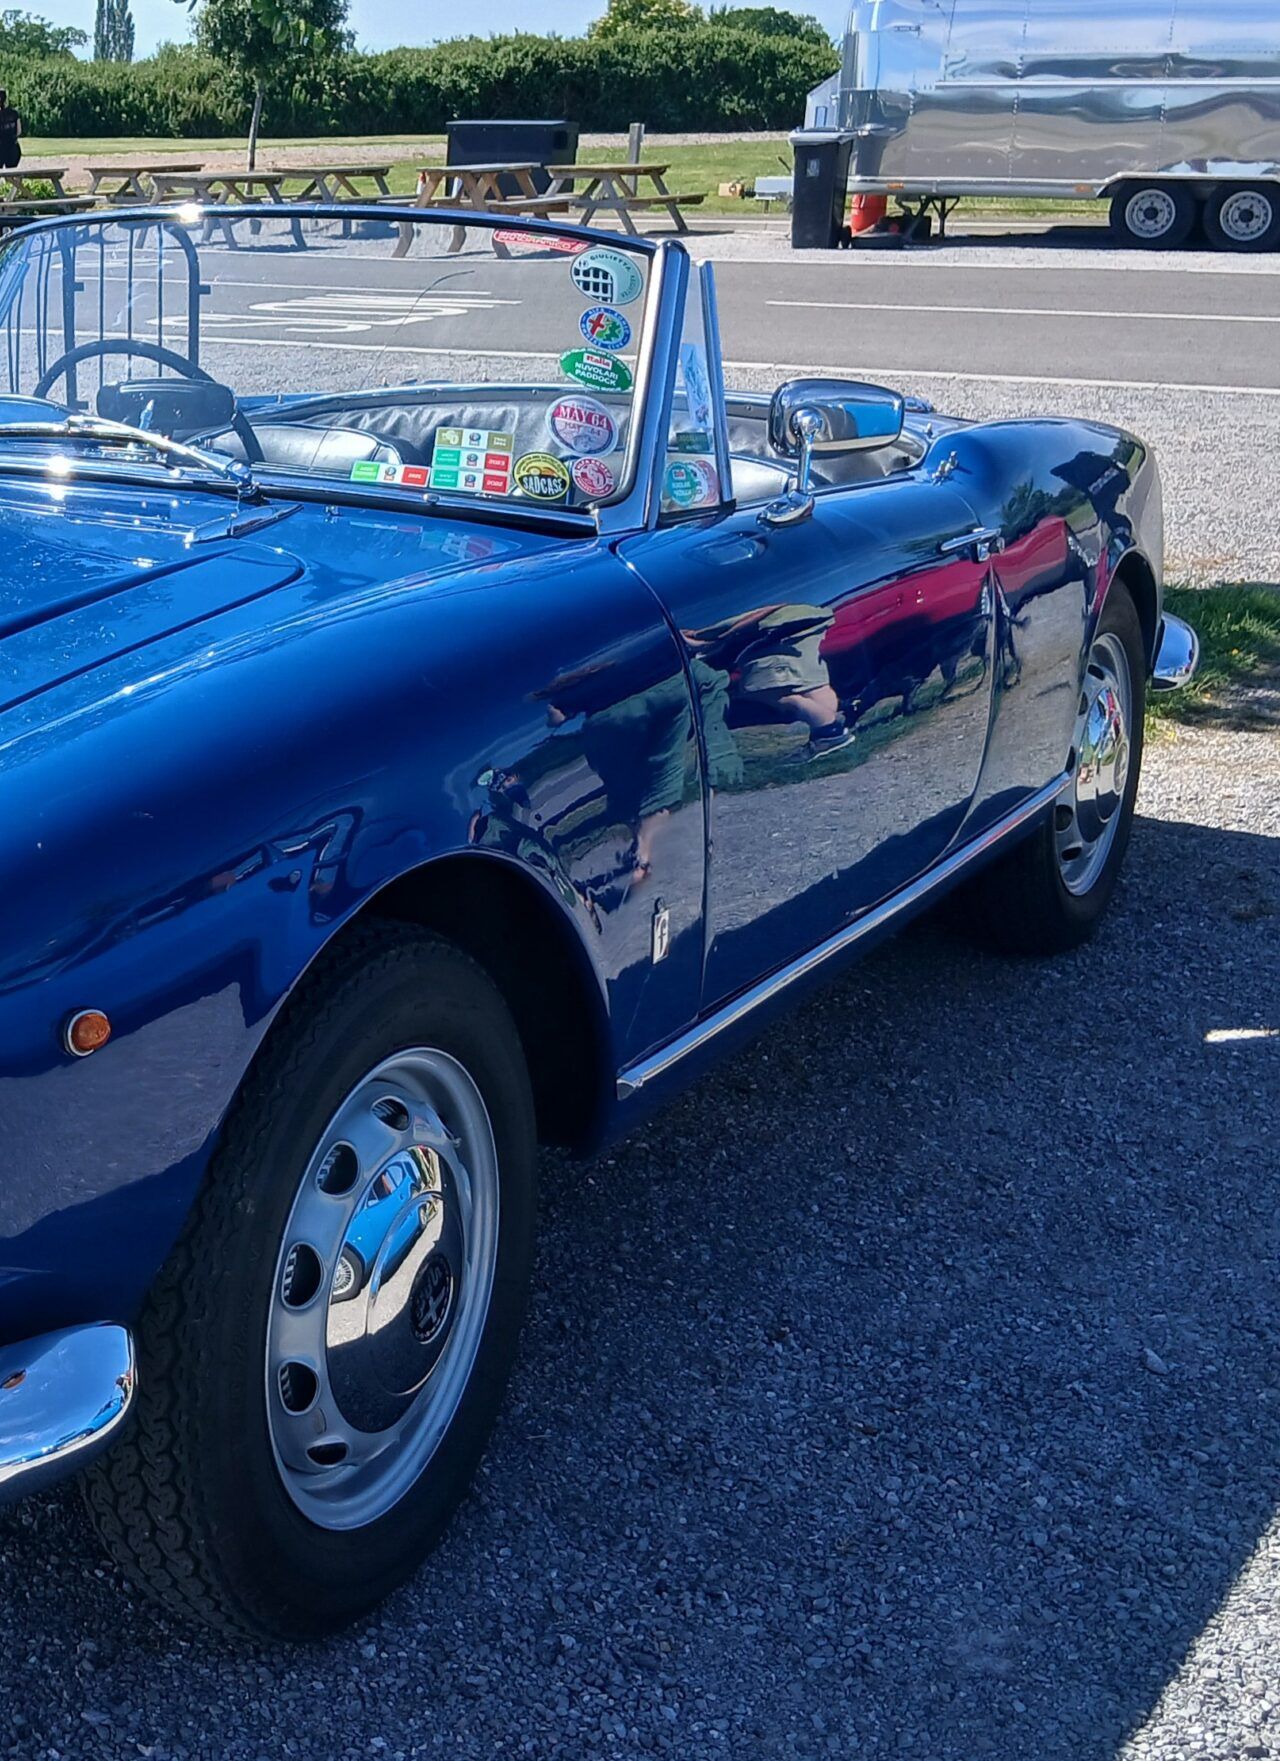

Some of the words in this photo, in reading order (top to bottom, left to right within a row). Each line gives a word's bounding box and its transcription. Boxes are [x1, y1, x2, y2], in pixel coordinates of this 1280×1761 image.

[575, 362, 618, 380] NUVOLARI
[575, 369, 616, 386] PADDOCK
[559, 405, 589, 423] MAY
[592, 414, 607, 428] 64
[522, 476, 563, 495] SADCASE
